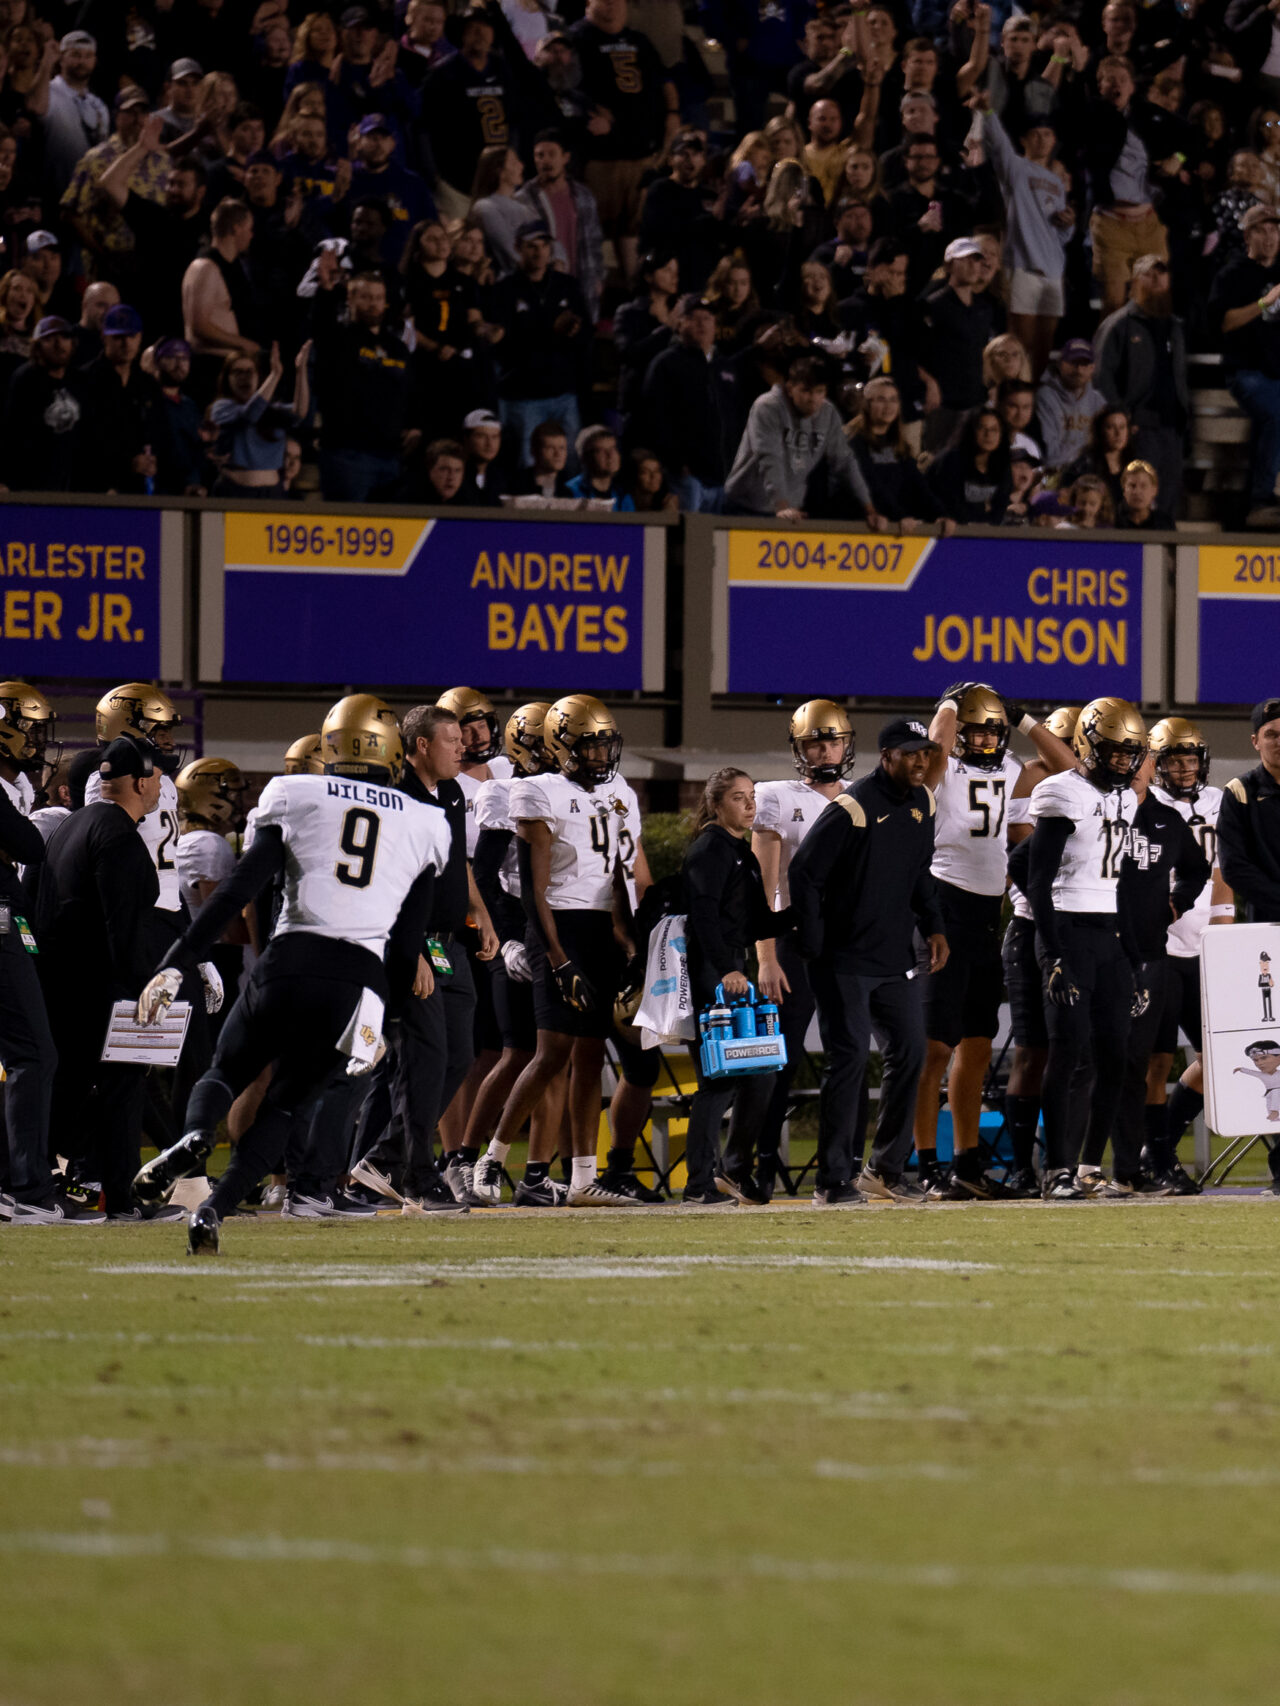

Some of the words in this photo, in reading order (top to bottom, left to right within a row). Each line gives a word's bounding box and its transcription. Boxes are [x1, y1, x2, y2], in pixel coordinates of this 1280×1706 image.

[477, 96, 509, 143] 2
[264, 523, 395, 559] 1996-1999
[757, 539, 904, 573] 2004-2007
[470, 551, 629, 593] ANDREW
[1027, 566, 1129, 608] CHRIS
[0, 589, 63, 641] ER
[76, 592, 145, 642] JR.
[487, 602, 629, 653] BAYES
[912, 614, 1128, 666] JOHNSON
[352, 738, 361, 757] 9
[327, 781, 404, 812] WILSON
[968, 779, 1006, 838] 57
[334, 805, 382, 891] 9
[725, 1046, 778, 1059] POWERADE
